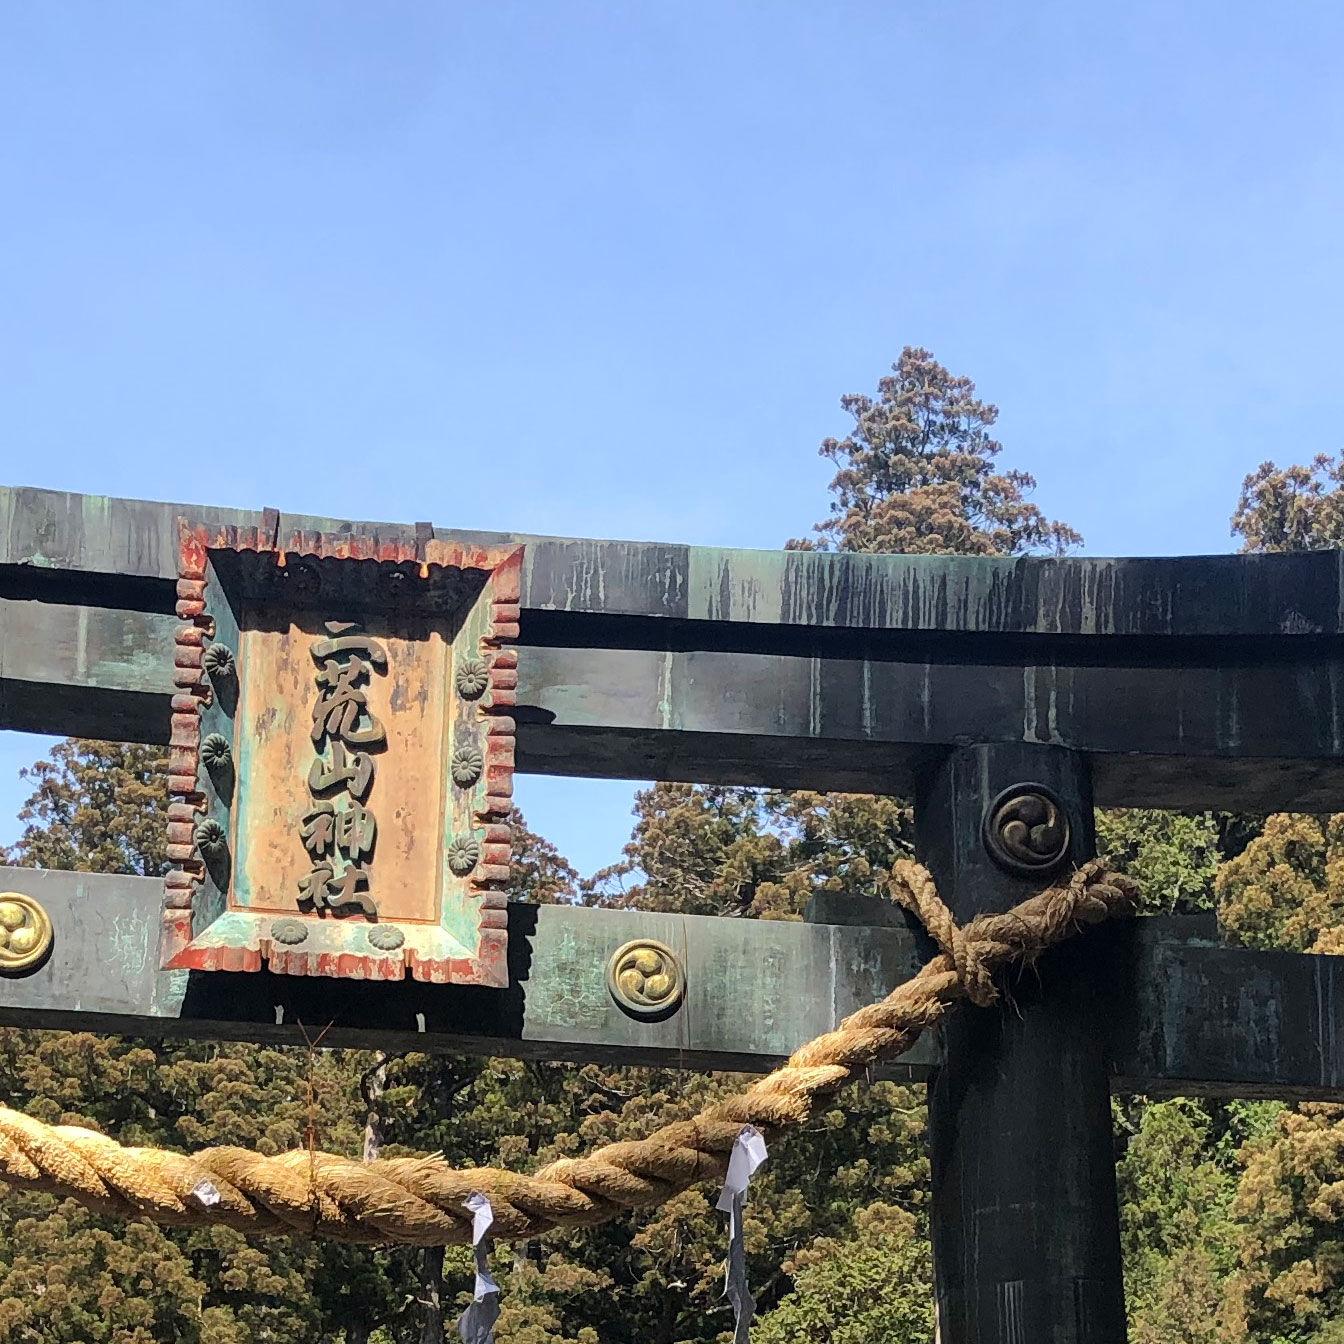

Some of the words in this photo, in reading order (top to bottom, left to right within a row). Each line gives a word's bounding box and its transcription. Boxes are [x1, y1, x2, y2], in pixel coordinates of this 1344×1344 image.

[299, 621, 387, 920] 二荒山神社
